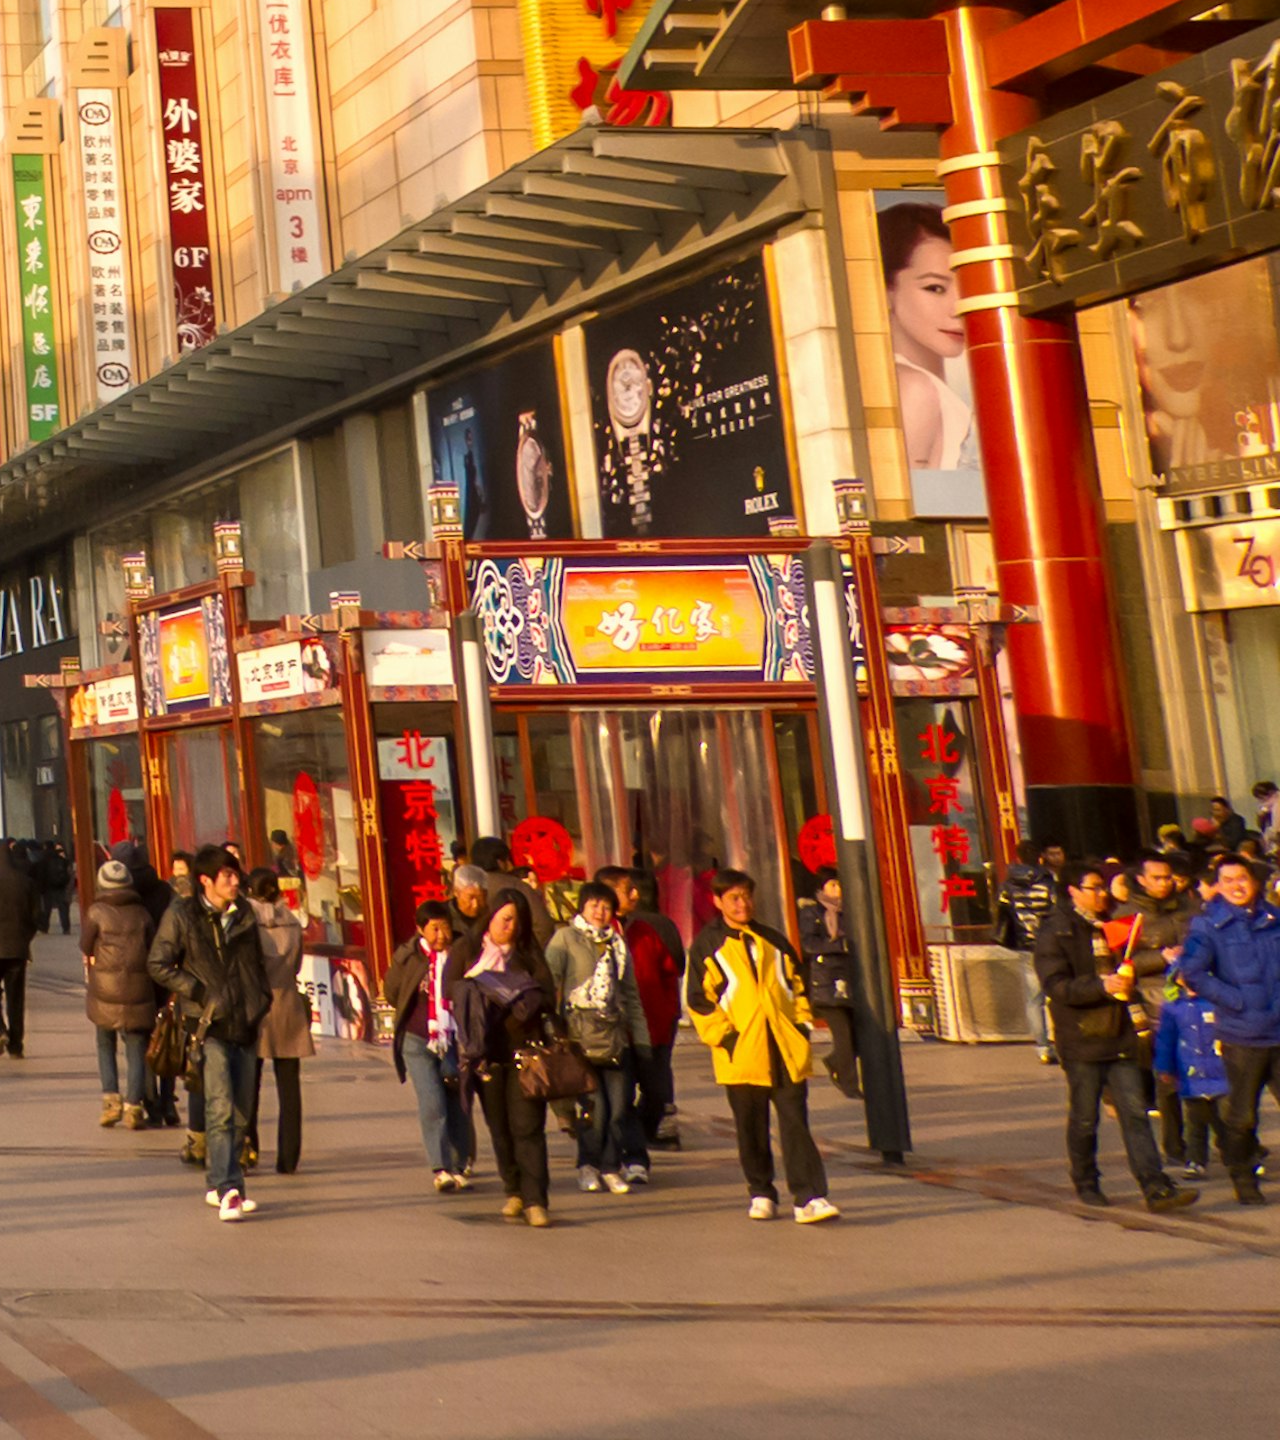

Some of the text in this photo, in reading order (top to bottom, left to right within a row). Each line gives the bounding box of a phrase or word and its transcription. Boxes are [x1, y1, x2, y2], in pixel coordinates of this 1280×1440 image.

[85, 153, 113, 166] 著名
[164, 98, 205, 214] 外婆家
[281, 135, 299, 175] 北京
[86, 171, 114, 184] 时装
[86, 189, 115, 202] 零售
[276, 186, 313, 204] apm
[87, 206, 116, 219] 品牌
[174, 246, 209, 268] 6F
[94, 284, 122, 297] 著名
[93, 303, 123, 315] 时装
[95, 321, 125, 334] 零售
[96, 339, 126, 352] 品牌
[706, 389, 723, 403] FOR
[724, 374, 769, 399] GREATNESS
[30, 403, 58, 421] 5F
[744, 492, 779, 516] ROLEX
[597, 600, 722, 651] 好亿家
[918, 723, 977, 913] 北京特产
